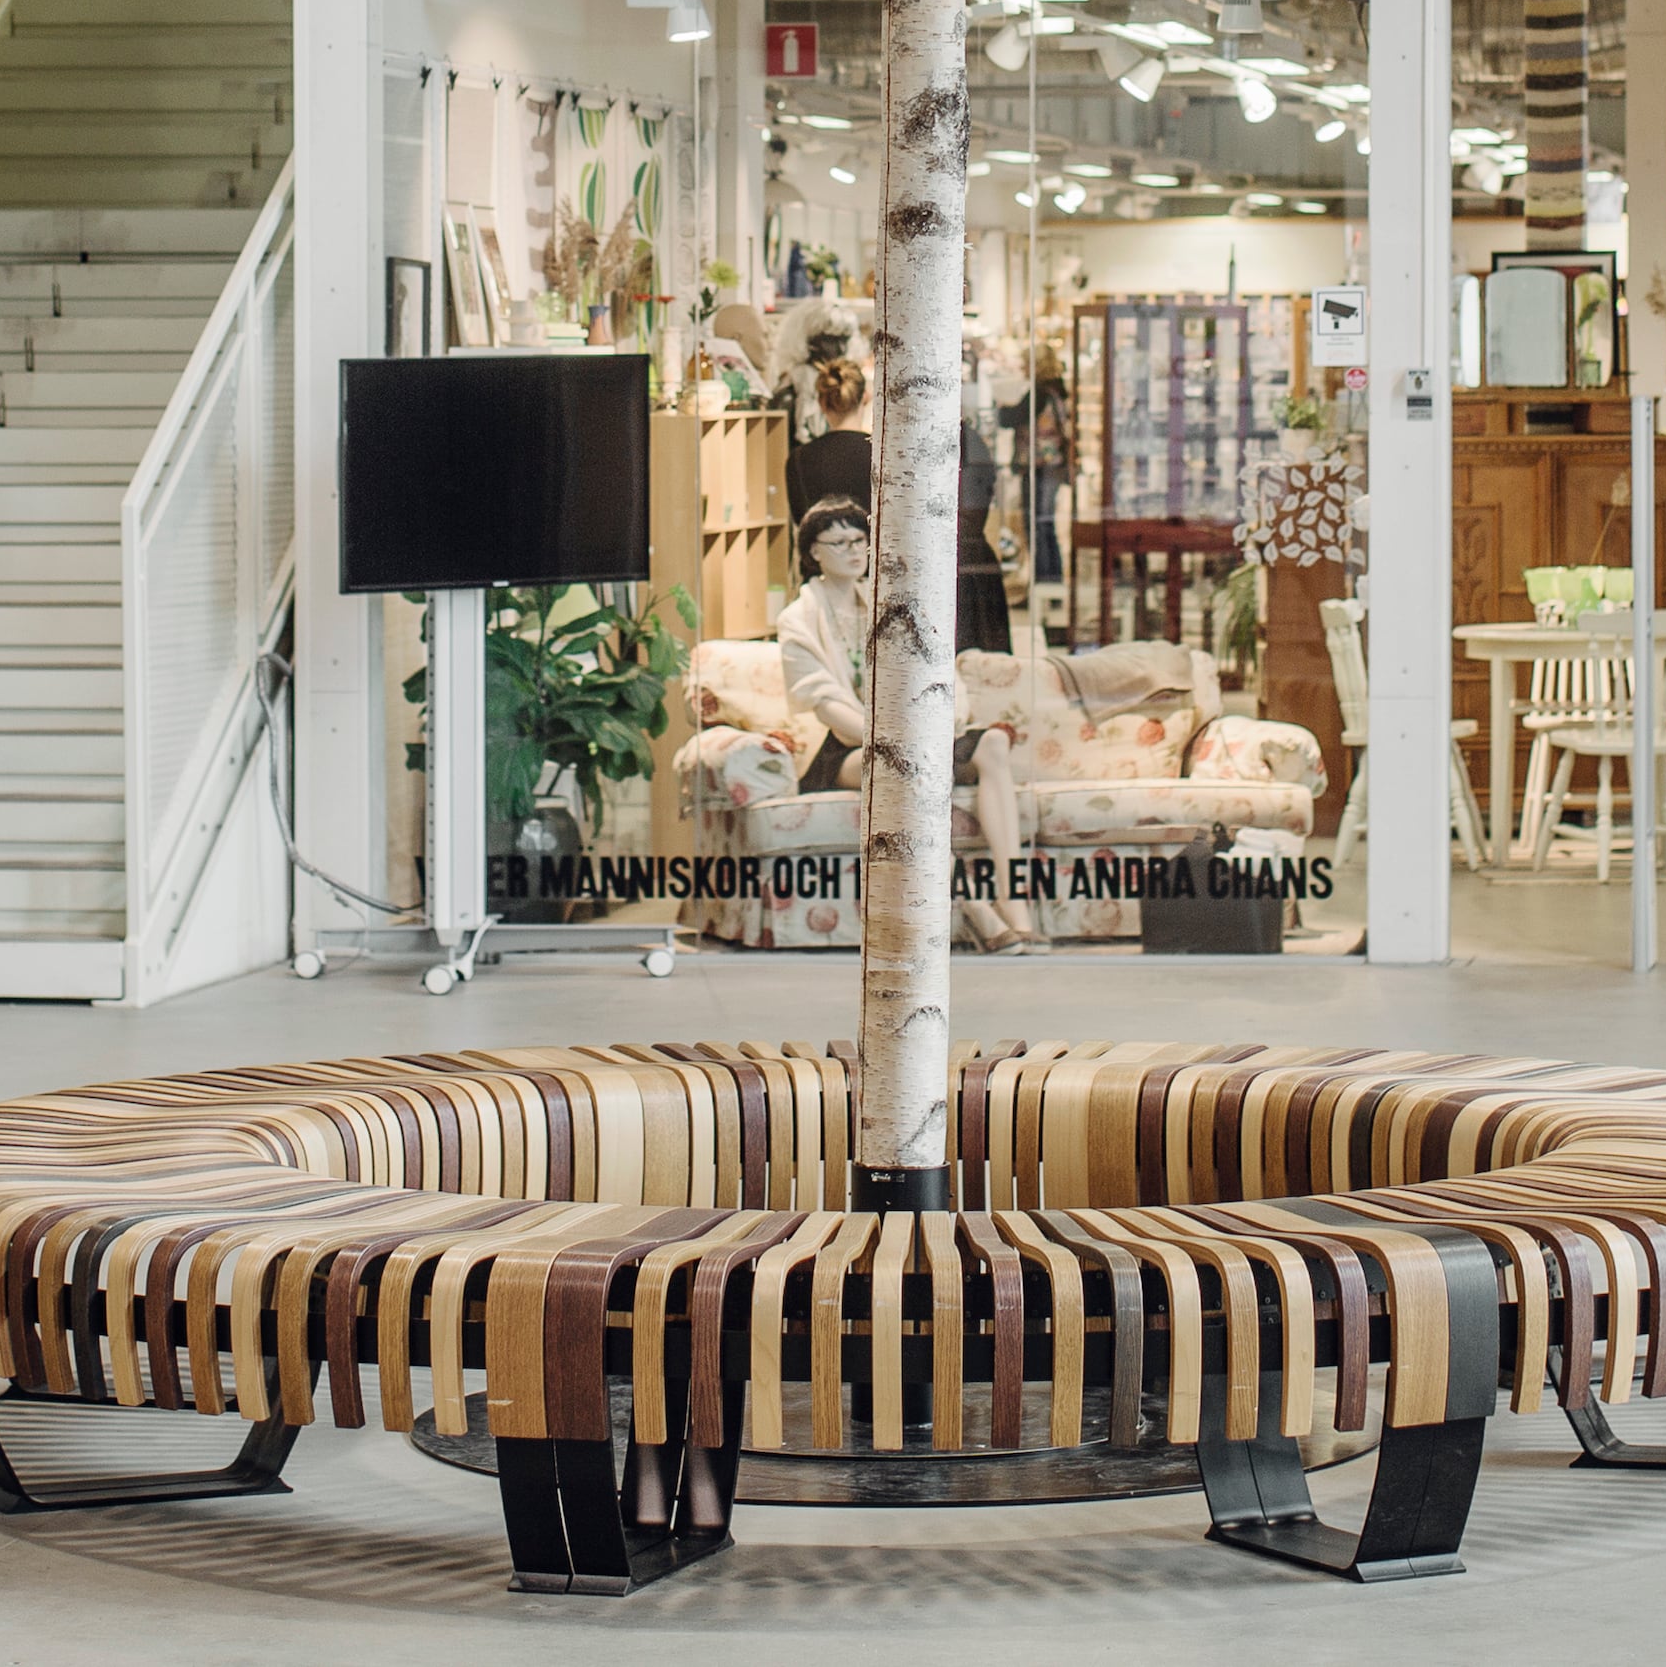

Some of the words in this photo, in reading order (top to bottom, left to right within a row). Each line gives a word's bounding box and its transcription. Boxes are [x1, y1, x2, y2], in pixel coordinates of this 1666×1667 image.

[539, 844, 762, 900] MÄNNISKOR
[773, 854, 841, 899] OCH
[1008, 857, 1056, 900] EN
[1069, 856, 1196, 901] ANDRA
[1207, 856, 1333, 900] CHANS
